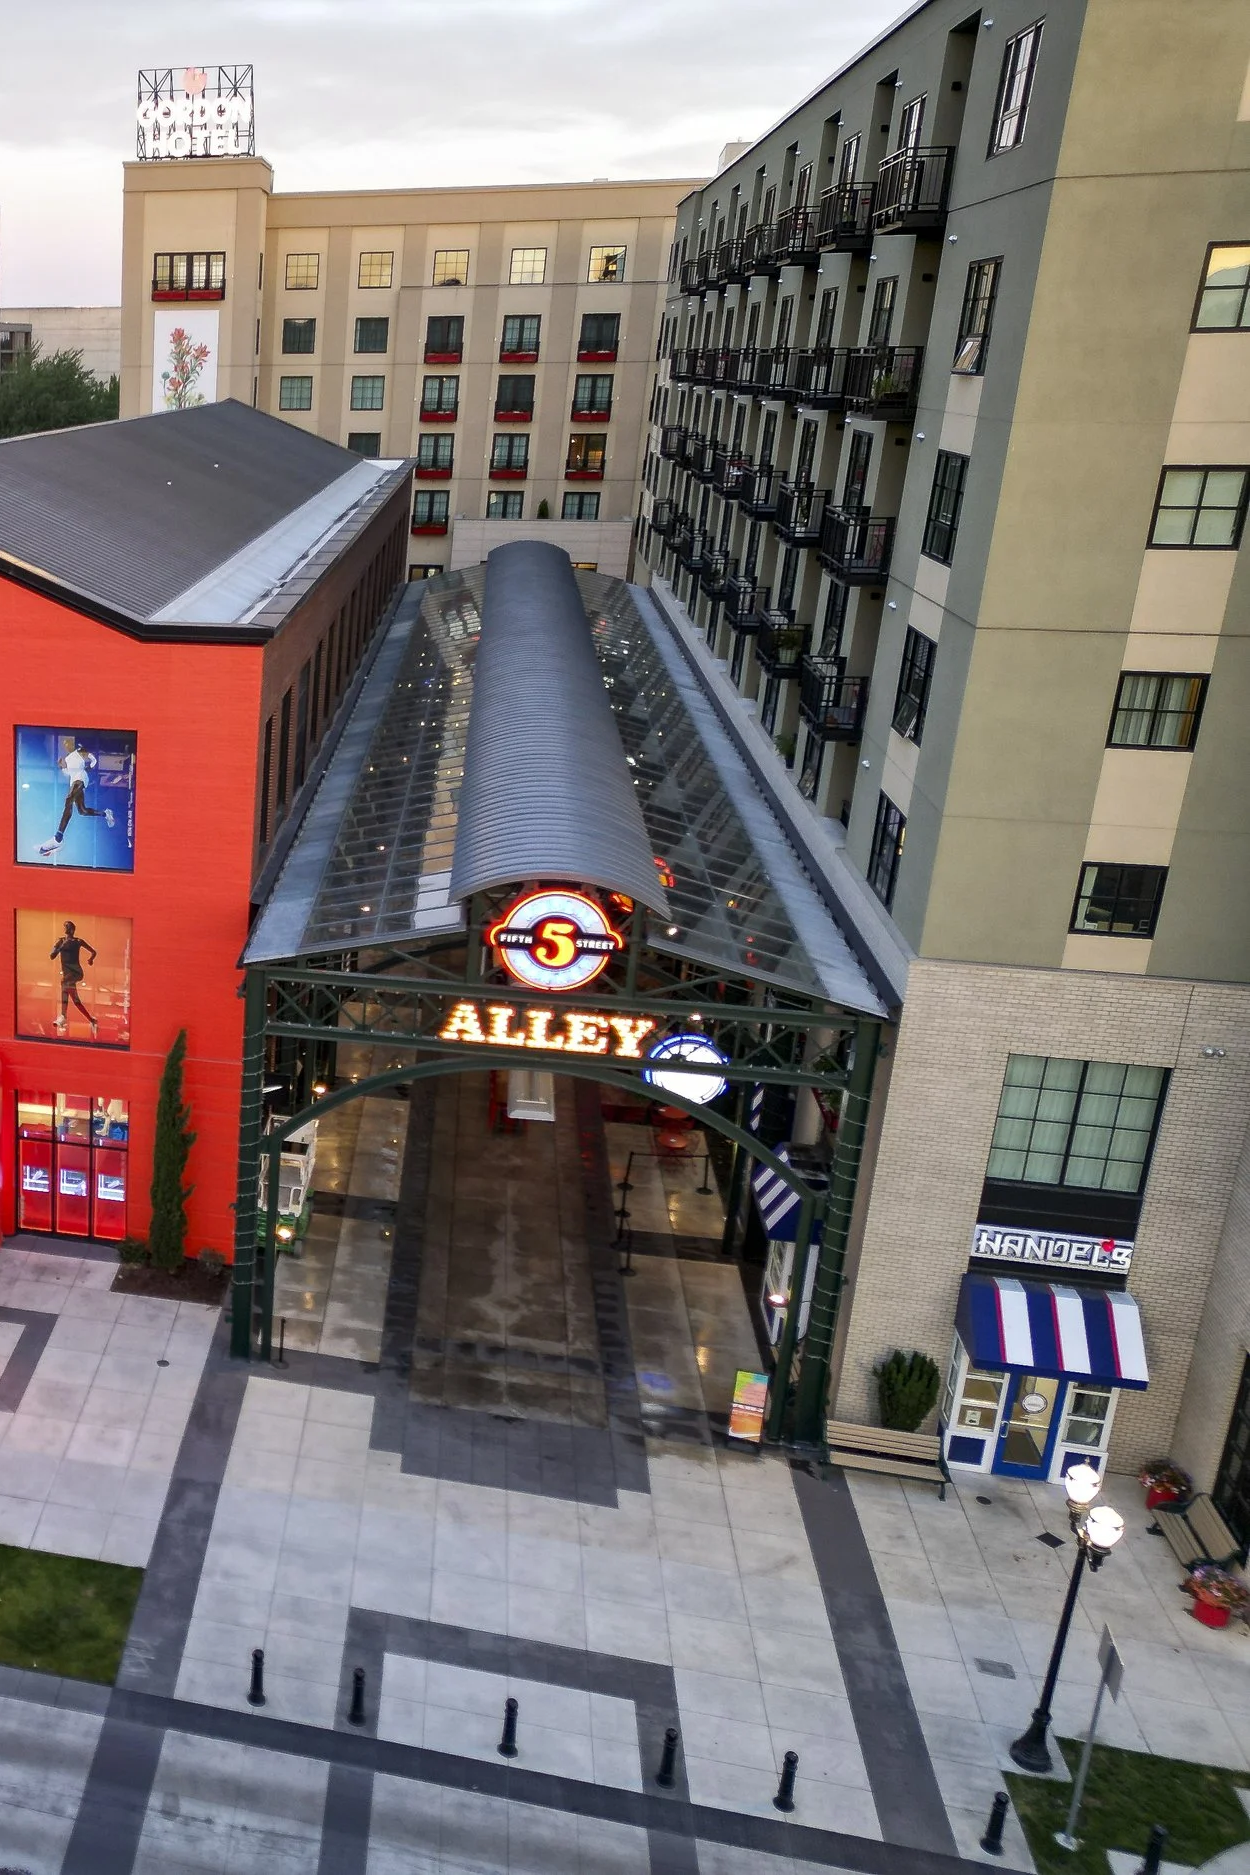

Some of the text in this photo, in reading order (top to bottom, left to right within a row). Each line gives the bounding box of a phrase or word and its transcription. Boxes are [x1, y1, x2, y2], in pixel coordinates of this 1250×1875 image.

[137, 97, 251, 127] GORDON
[145, 128, 244, 157] HOTEL
[500, 922, 616, 967] FIFTH 5 STREET
[439, 1002, 656, 1059] ALLEY
